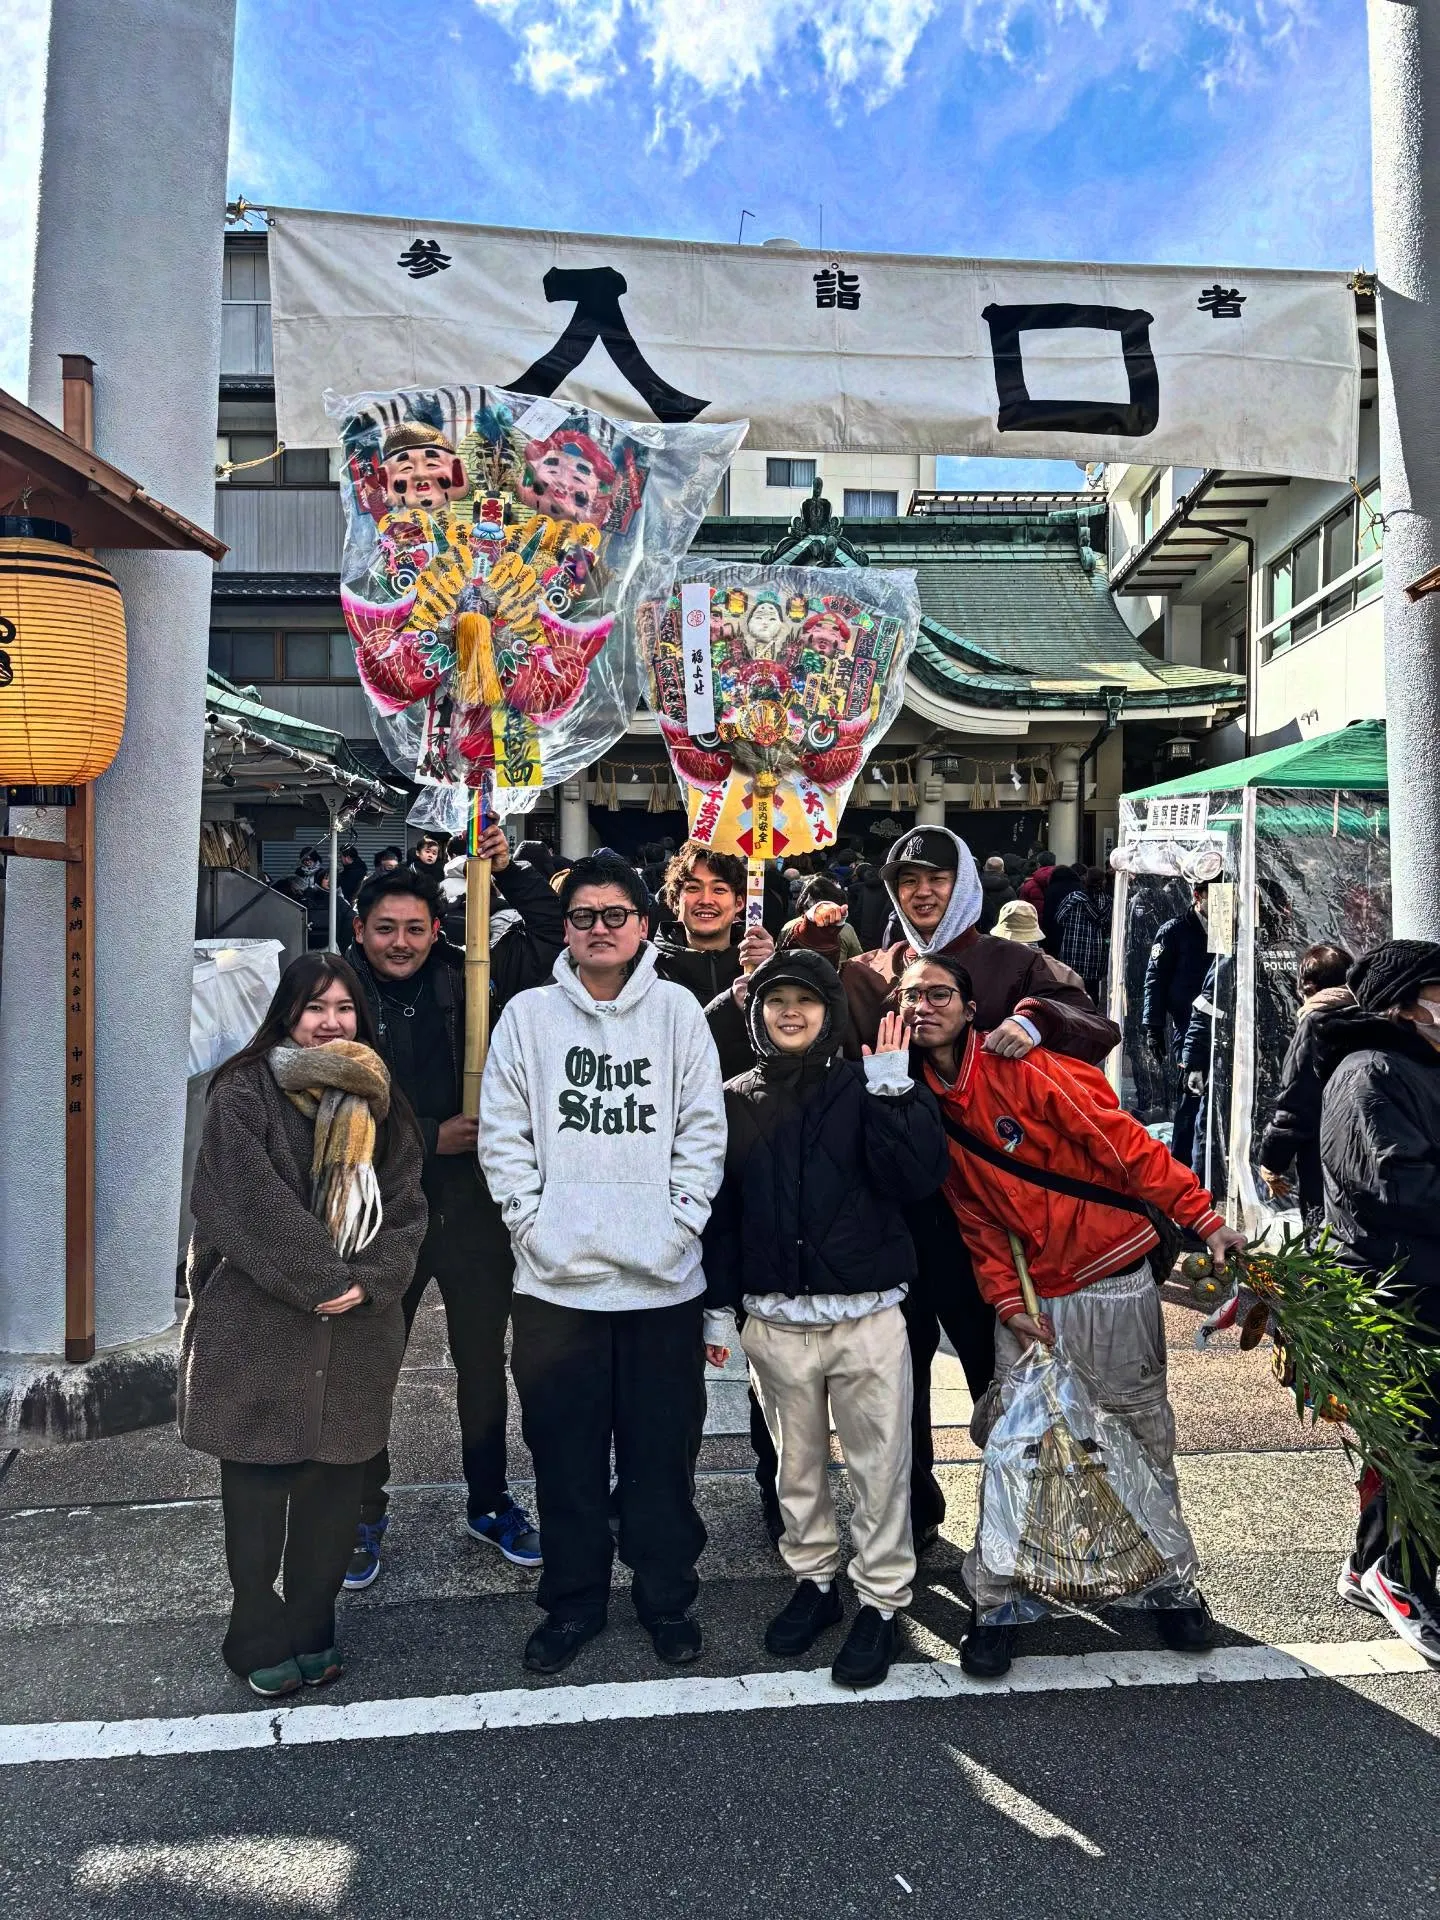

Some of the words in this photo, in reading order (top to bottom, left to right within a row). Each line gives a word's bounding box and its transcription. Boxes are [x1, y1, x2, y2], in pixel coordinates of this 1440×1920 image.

[690, 648, 705, 696] 福よせ
[757, 801, 769, 843] 家内安全
[1152, 803, 1201, 826] 警察官詰所
[69, 895, 83, 932] 奉納
[71, 951, 82, 1013] 株式会社
[1262, 961, 1297, 971] POLICE
[69, 1046, 83, 1114] 中野組
[565, 1045, 652, 1092] Olive
[557, 1089, 657, 1135] State
